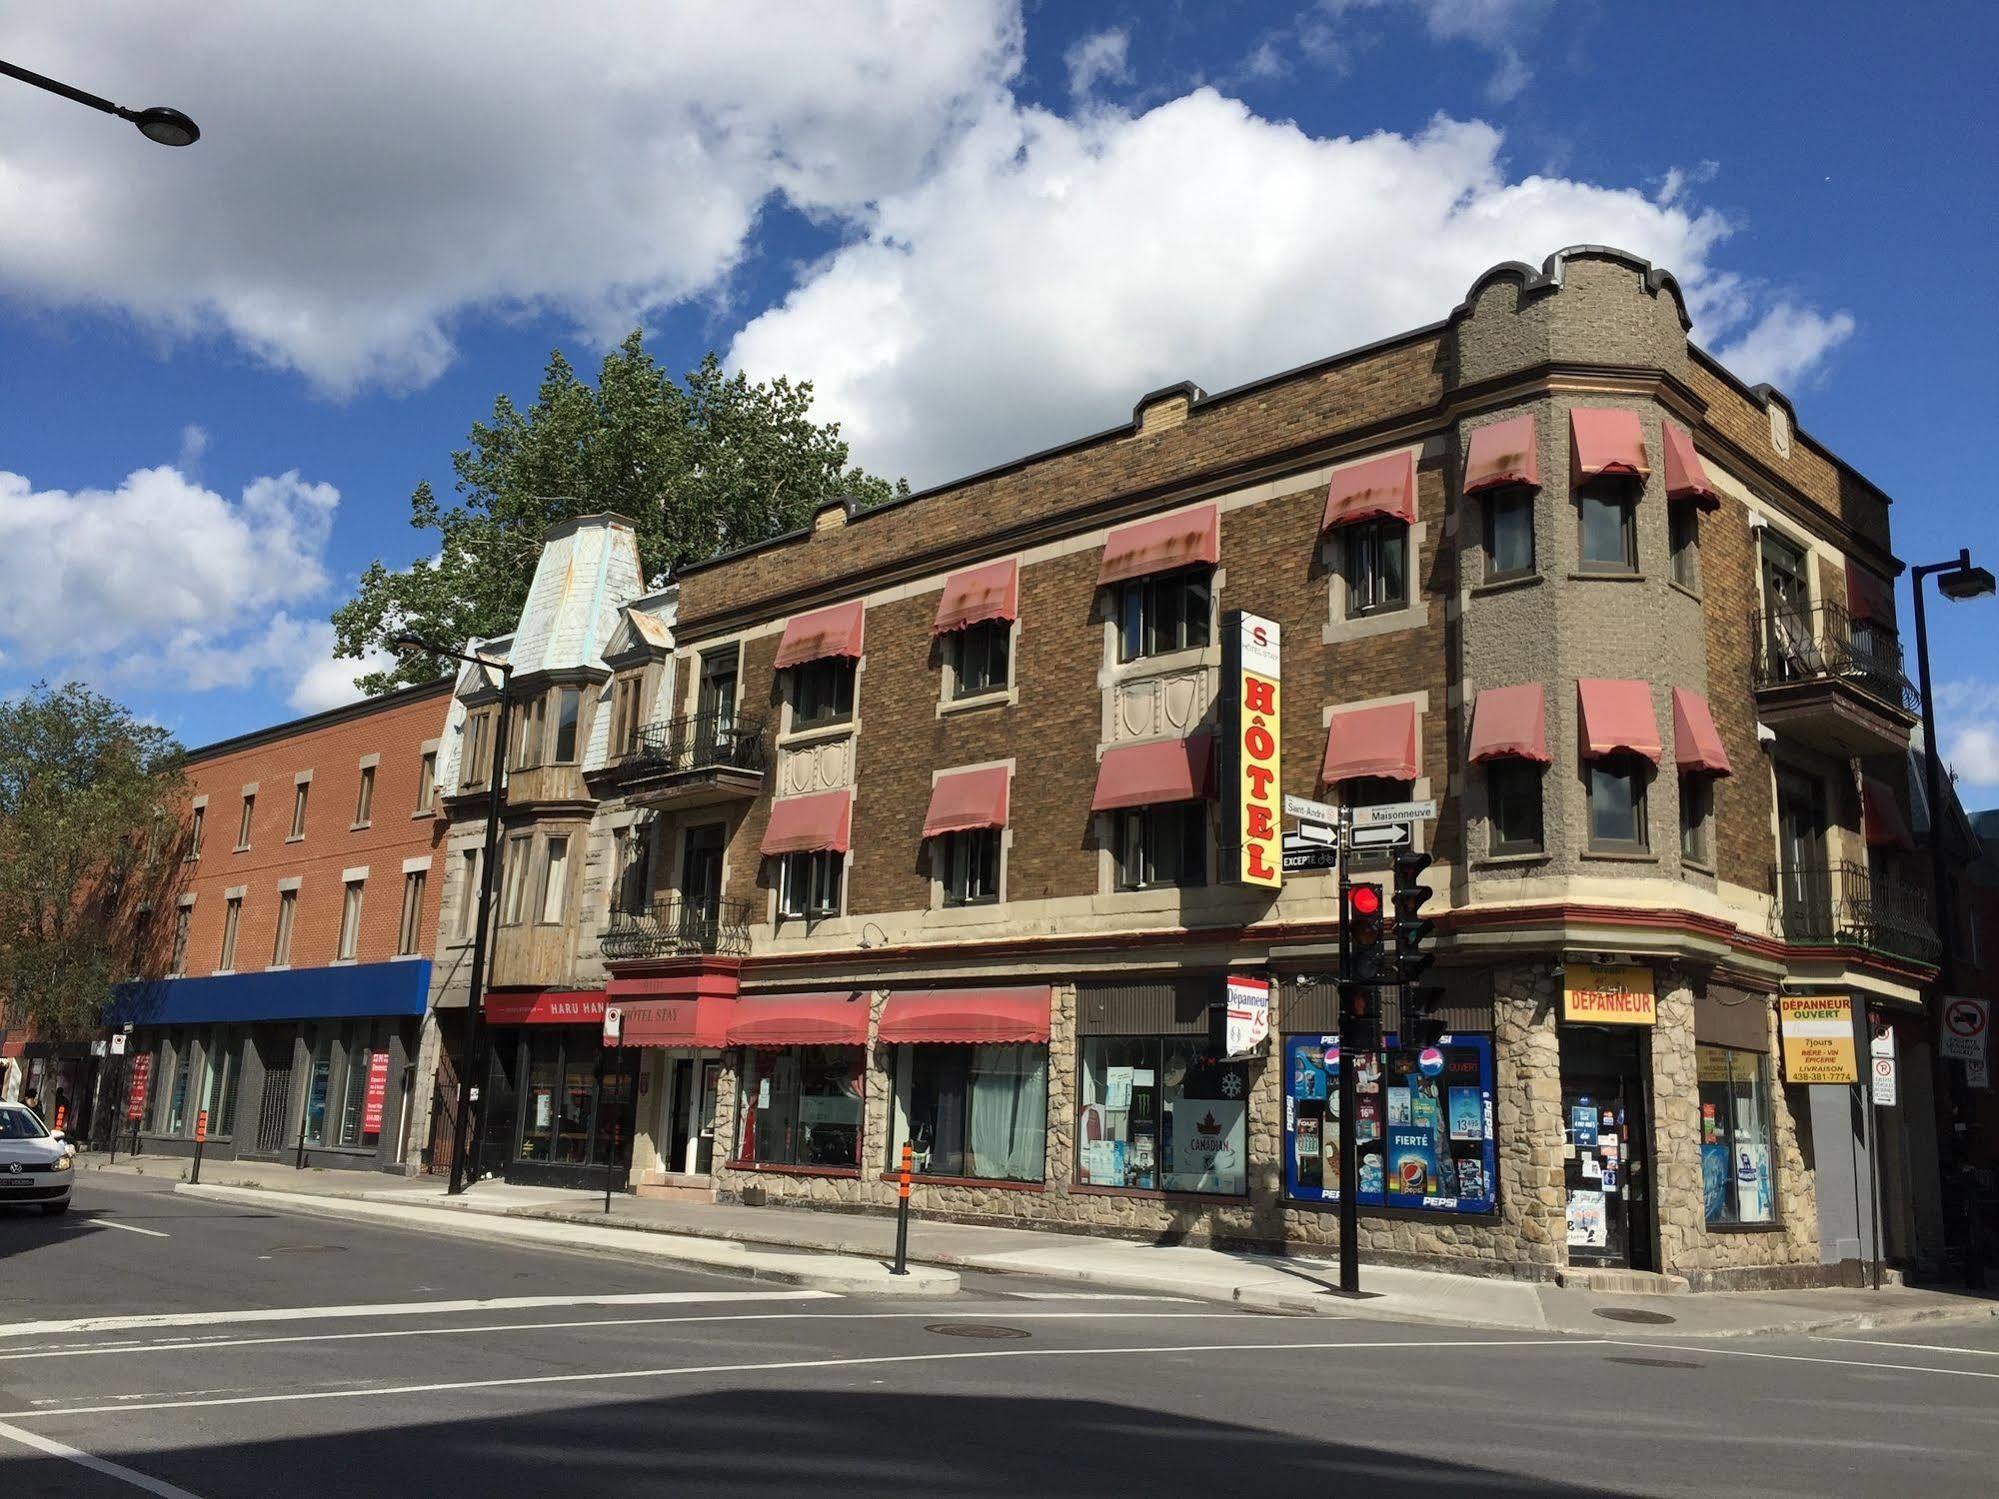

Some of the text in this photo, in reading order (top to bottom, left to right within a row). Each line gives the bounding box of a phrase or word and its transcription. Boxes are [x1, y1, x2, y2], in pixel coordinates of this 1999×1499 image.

[1254, 627, 1267, 647] S
[1245, 677, 1274, 880] HÔTEL
[1371, 809, 1431, 821] Maisonneuve
[1227, 988, 1269, 1009] Dépanneur
[1782, 999, 1851, 1010] DÉPANNEUR
[551, 1003, 579, 1015] HARU
[656, 1007, 680, 1021] STAY
[1794, 1010, 1840, 1019] OUVERT
[1793, 1072, 1851, 1081] 438-381-7774
[1286, 1095, 1295, 1132] PEPSI
[1483, 1100, 1493, 1139] PEPSI
[1191, 1137, 1229, 1151] CANADIAN
[1395, 1133, 1428, 1146] FIERTÉ
[1422, 1196, 1458, 1208] PEPSI
